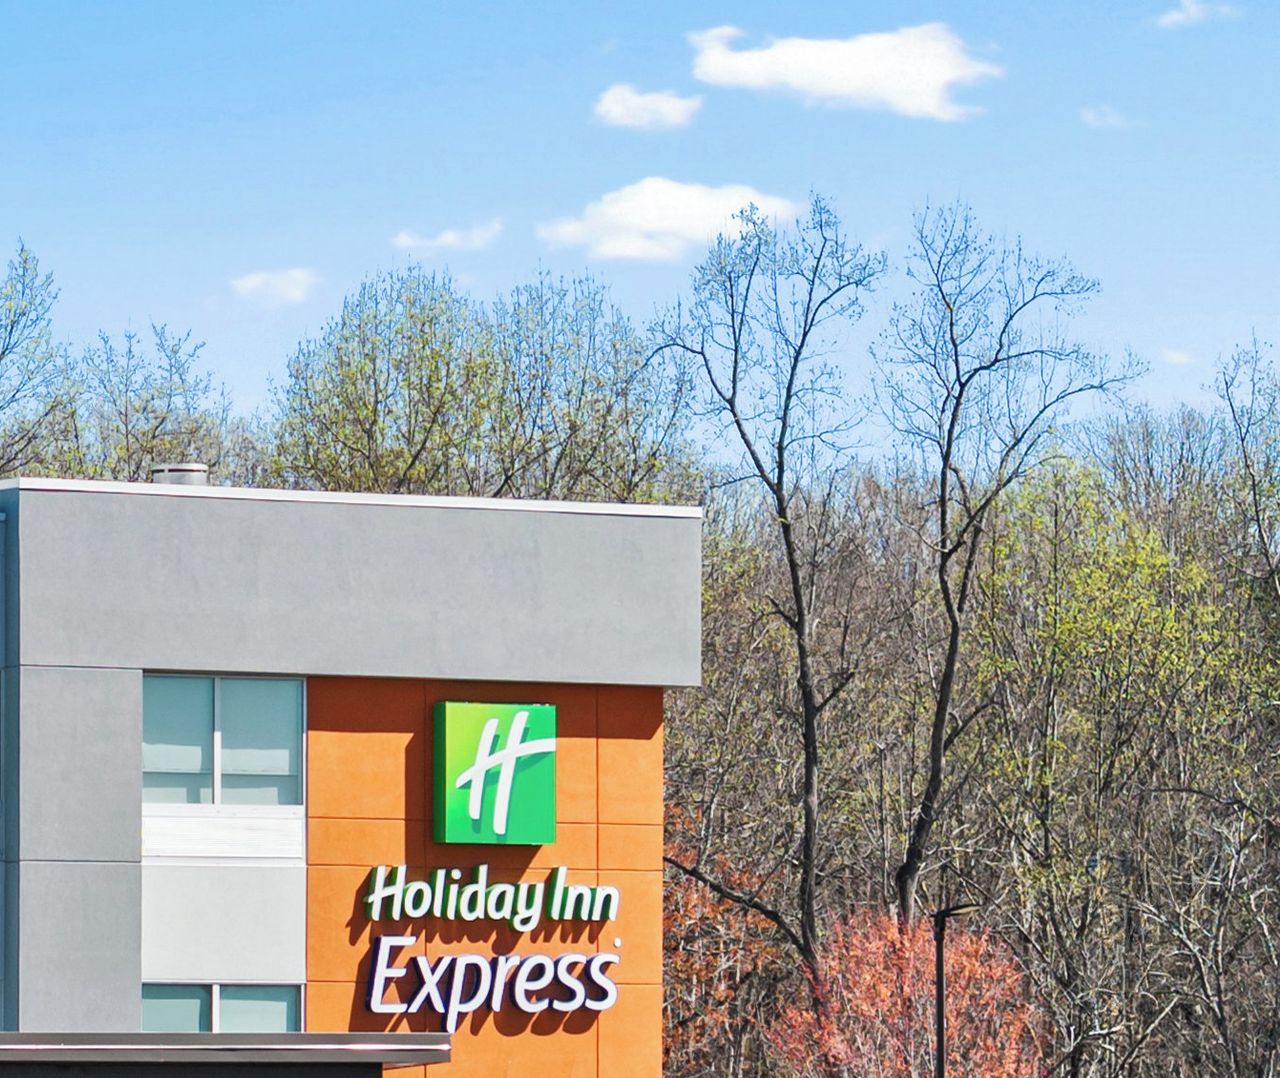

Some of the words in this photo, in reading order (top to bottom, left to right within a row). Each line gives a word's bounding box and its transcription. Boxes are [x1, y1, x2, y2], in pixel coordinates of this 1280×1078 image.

[366, 864, 544, 932] Holiday
[551, 866, 620, 921] Inn
[368, 936, 620, 1033] Express
